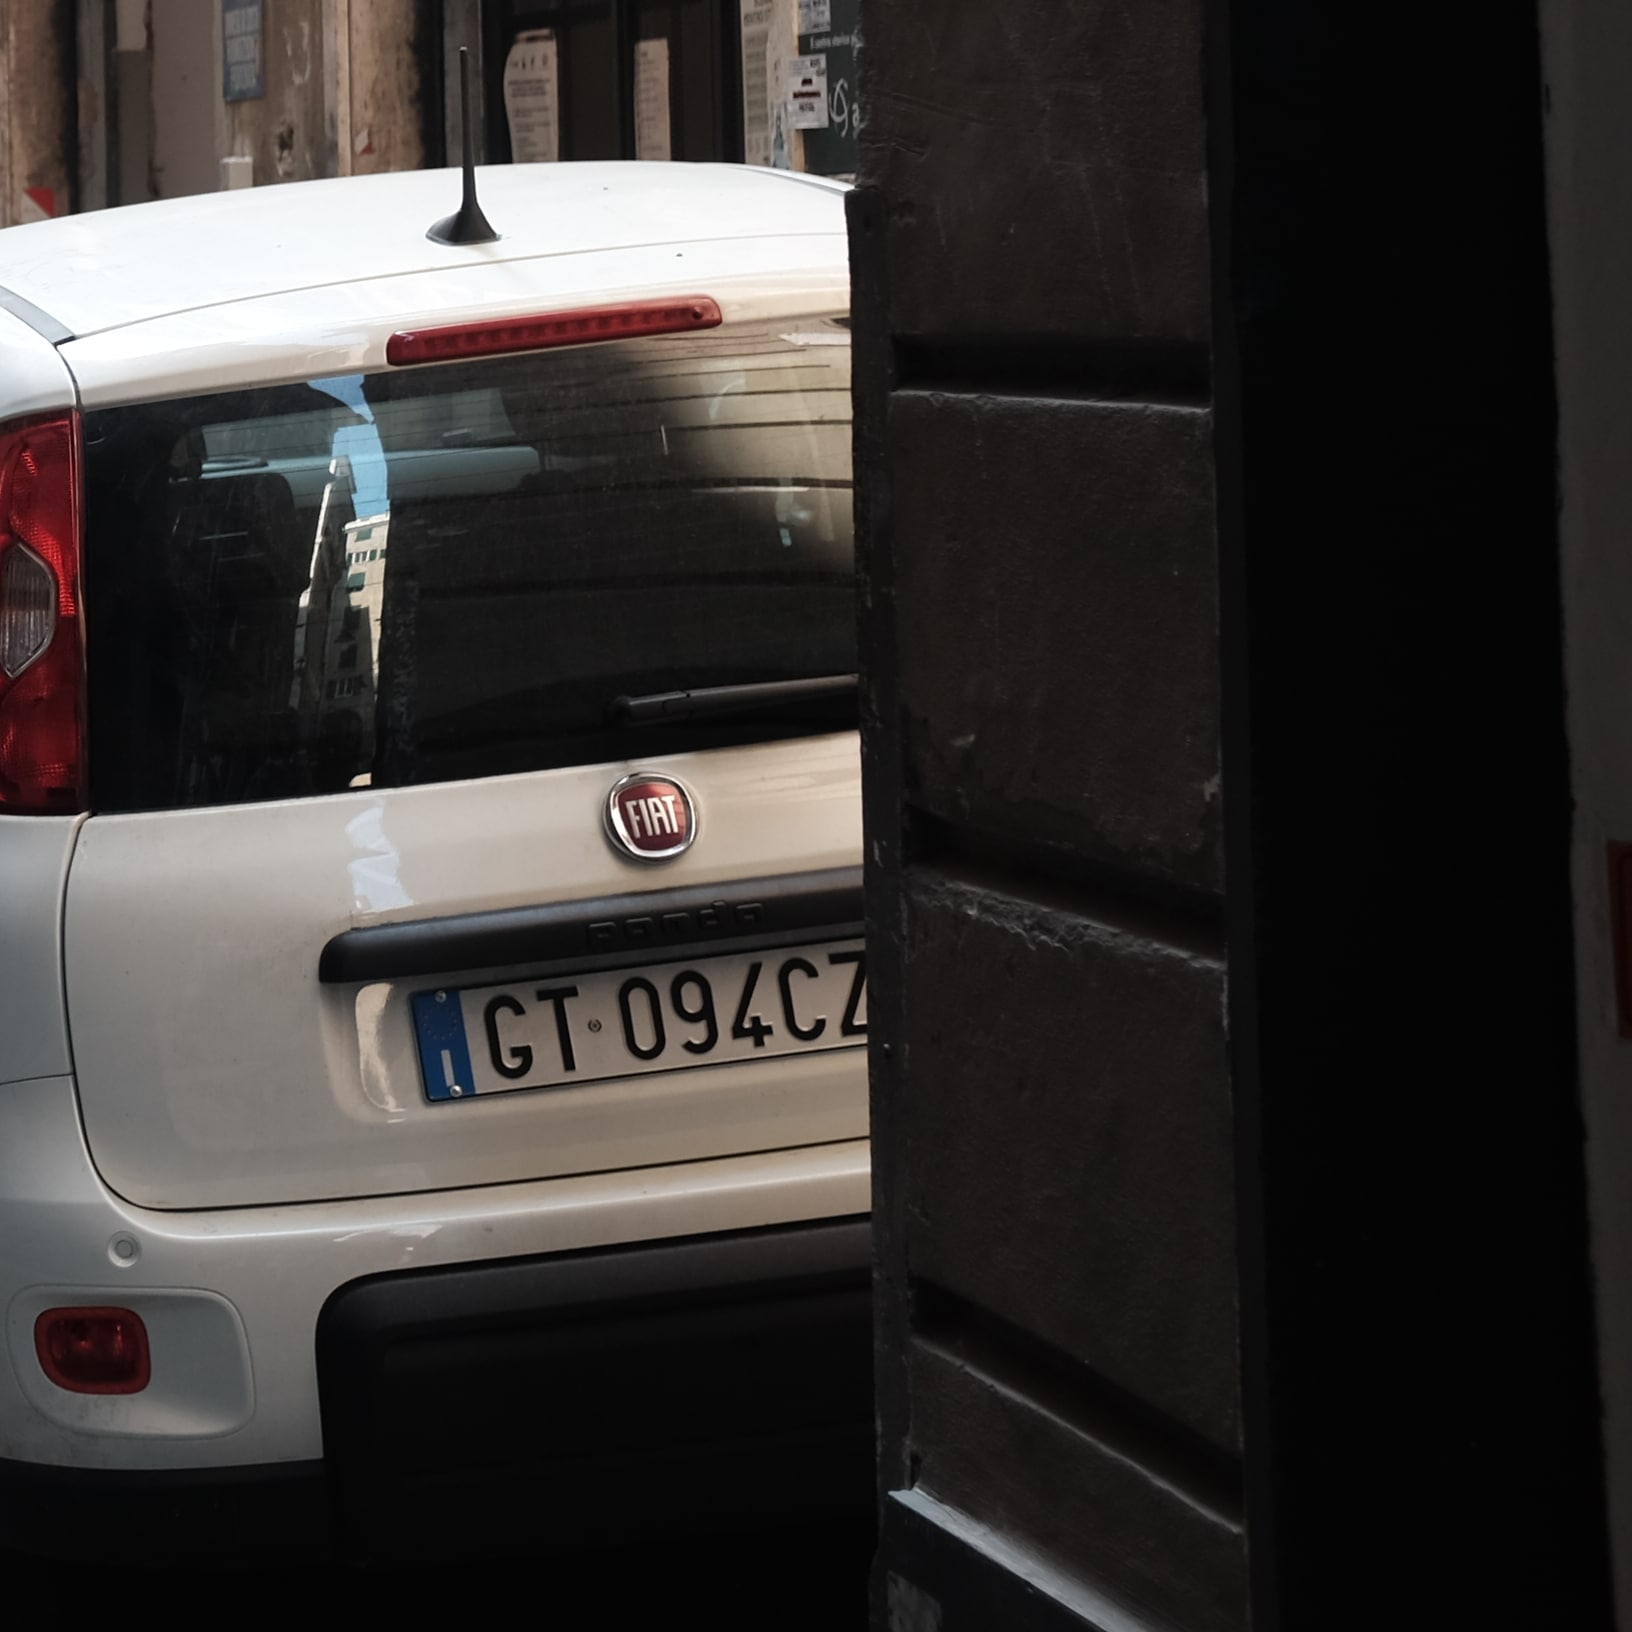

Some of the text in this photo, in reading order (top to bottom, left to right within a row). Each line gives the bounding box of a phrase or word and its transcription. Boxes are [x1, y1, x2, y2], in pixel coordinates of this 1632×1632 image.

[624, 793, 683, 839] FIAT
[586, 900, 765, 950] panda
[483, 984, 580, 1081] GT
